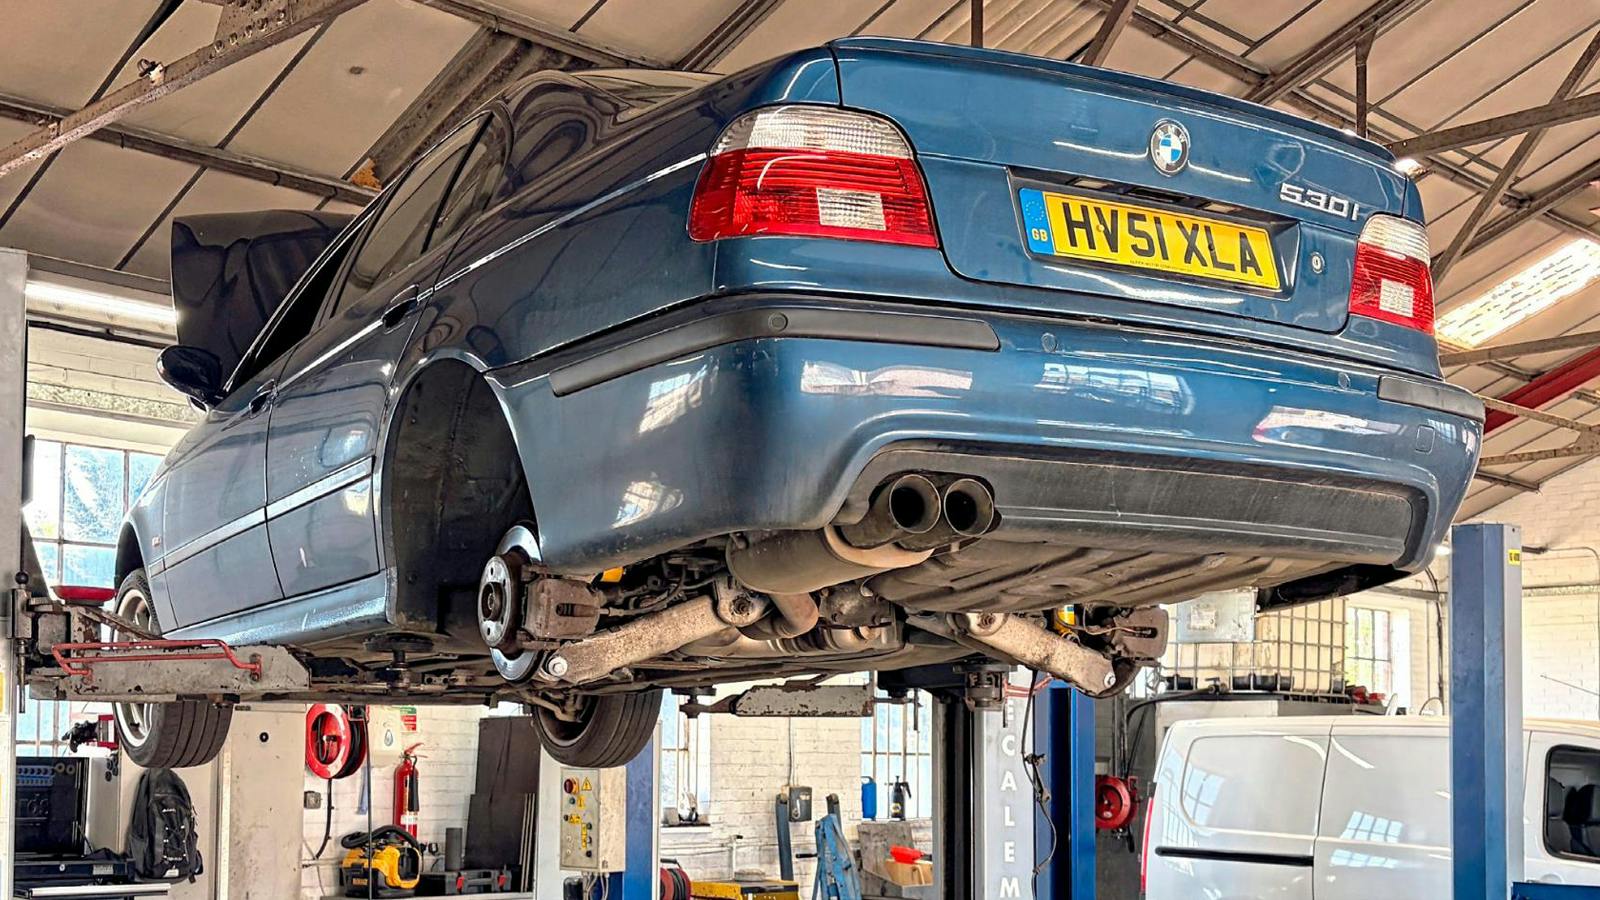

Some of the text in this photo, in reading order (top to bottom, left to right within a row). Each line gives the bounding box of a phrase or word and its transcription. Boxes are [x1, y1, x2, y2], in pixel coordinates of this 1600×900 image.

[1031, 227, 1048, 242] GB
[1061, 202, 1263, 278] HV51 XLA
[999, 672, 1020, 898] ECALEM
